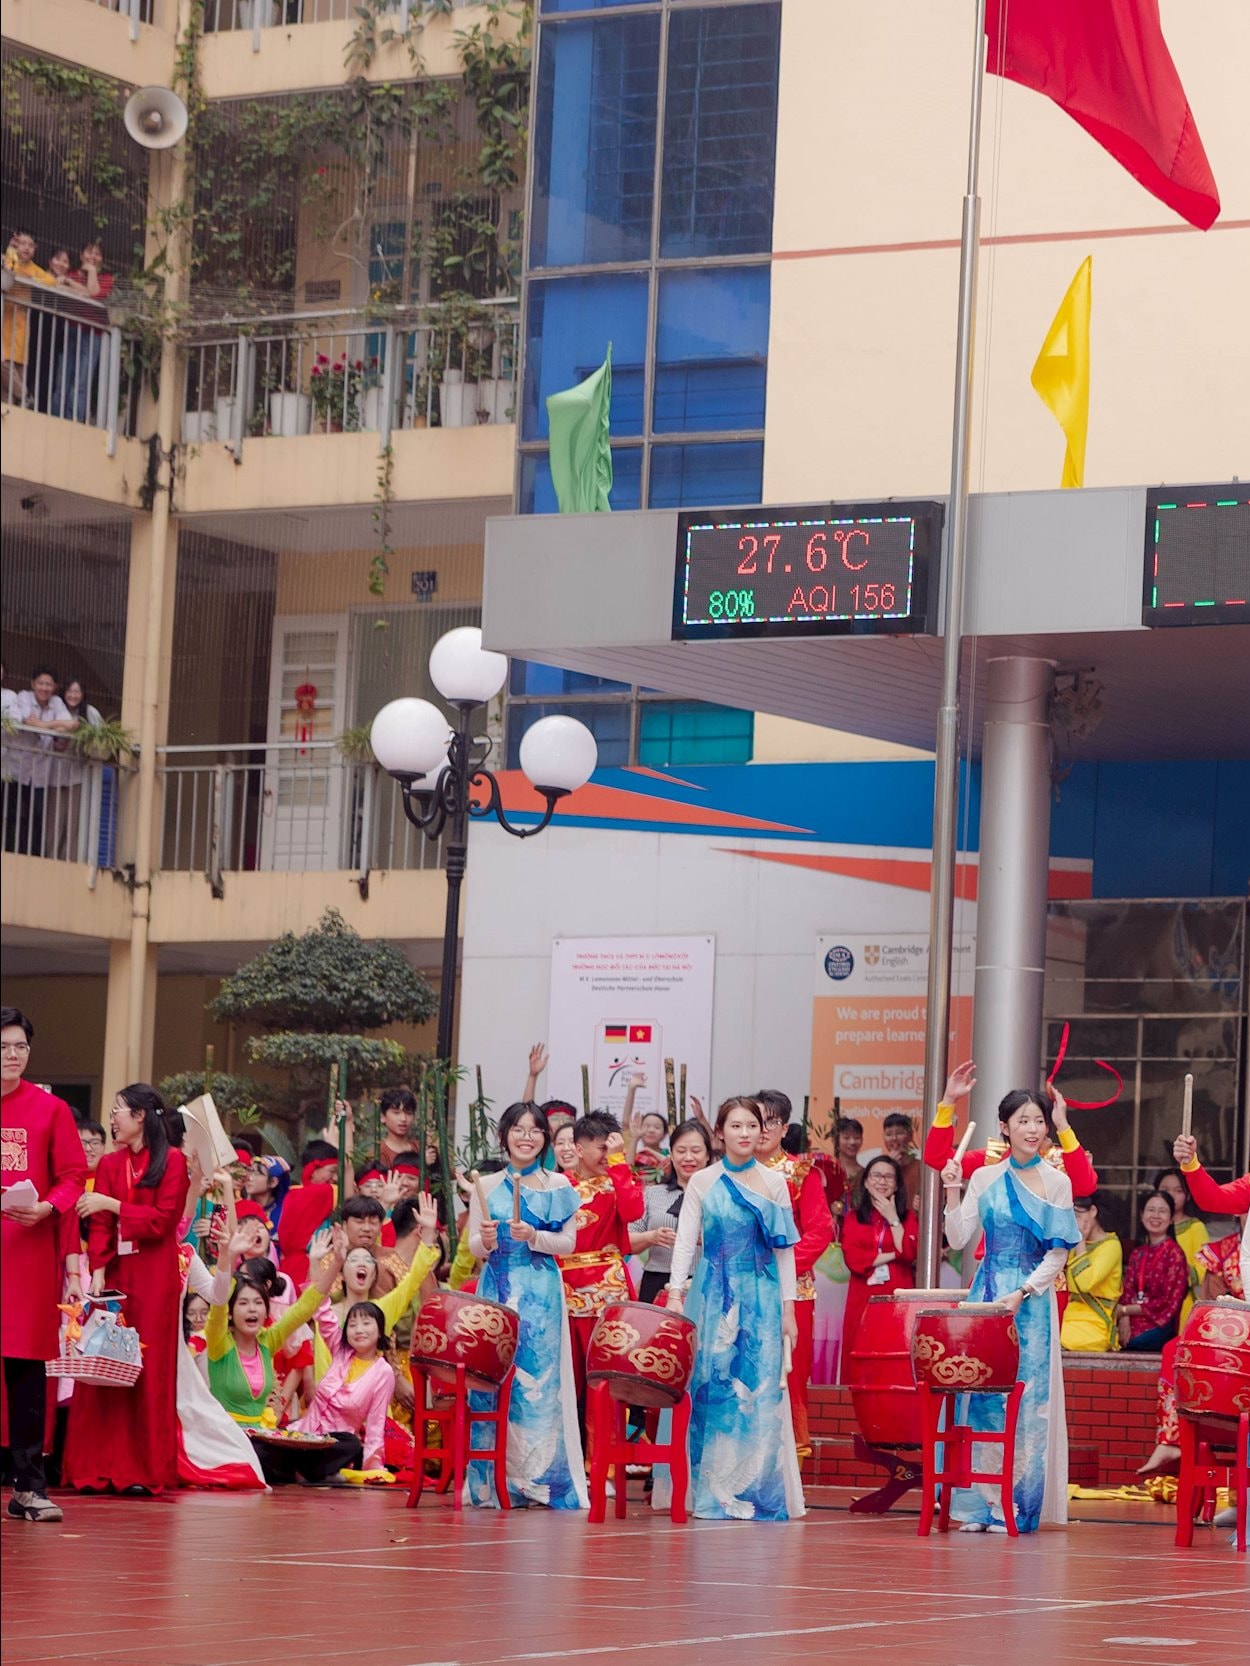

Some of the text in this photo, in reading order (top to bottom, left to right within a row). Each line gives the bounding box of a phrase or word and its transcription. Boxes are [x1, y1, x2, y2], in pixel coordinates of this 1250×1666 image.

[708, 583, 896, 617] 80% AQI 156
[882, 945, 924, 956] Cambridge
[836, 1006, 858, 1020] We
[860, 1008, 880, 1020] are
[882, 1004, 919, 1024] proud
[835, 1027, 926, 1045] prepare learne
[840, 1069, 924, 1095] Cambridg
